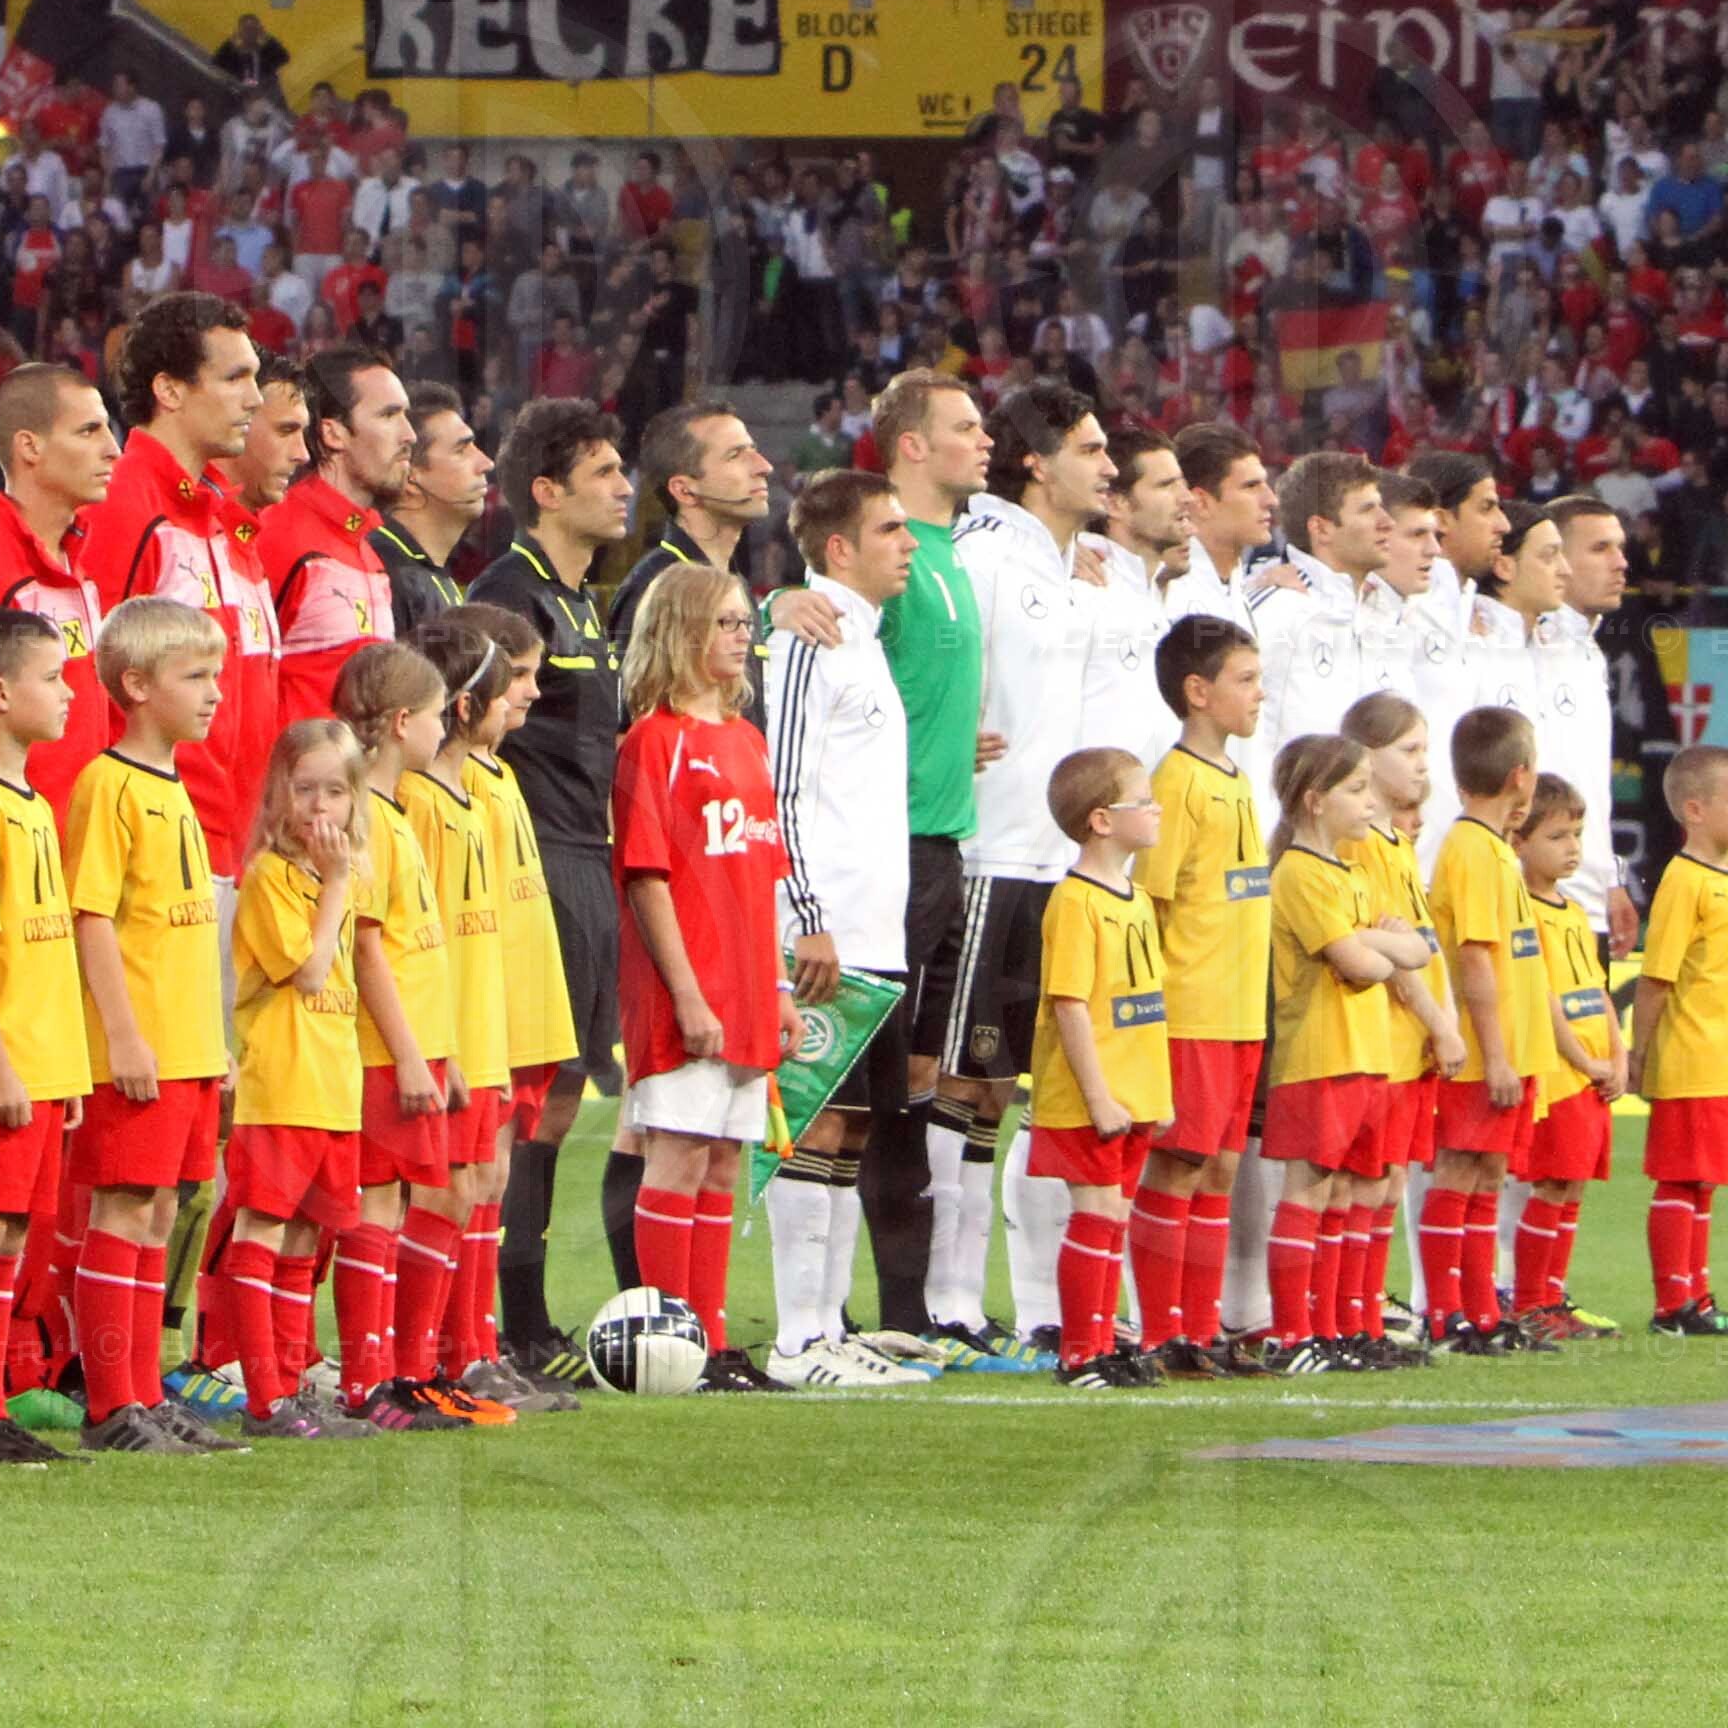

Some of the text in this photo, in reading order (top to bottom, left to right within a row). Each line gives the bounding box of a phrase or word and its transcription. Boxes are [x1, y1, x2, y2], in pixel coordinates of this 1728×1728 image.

[797, 11, 1094, 39] BLOCK STIEGE
[822, 43, 1079, 93] D 24
[918, 94, 955, 117] WC
[701, 797, 748, 857] 12
